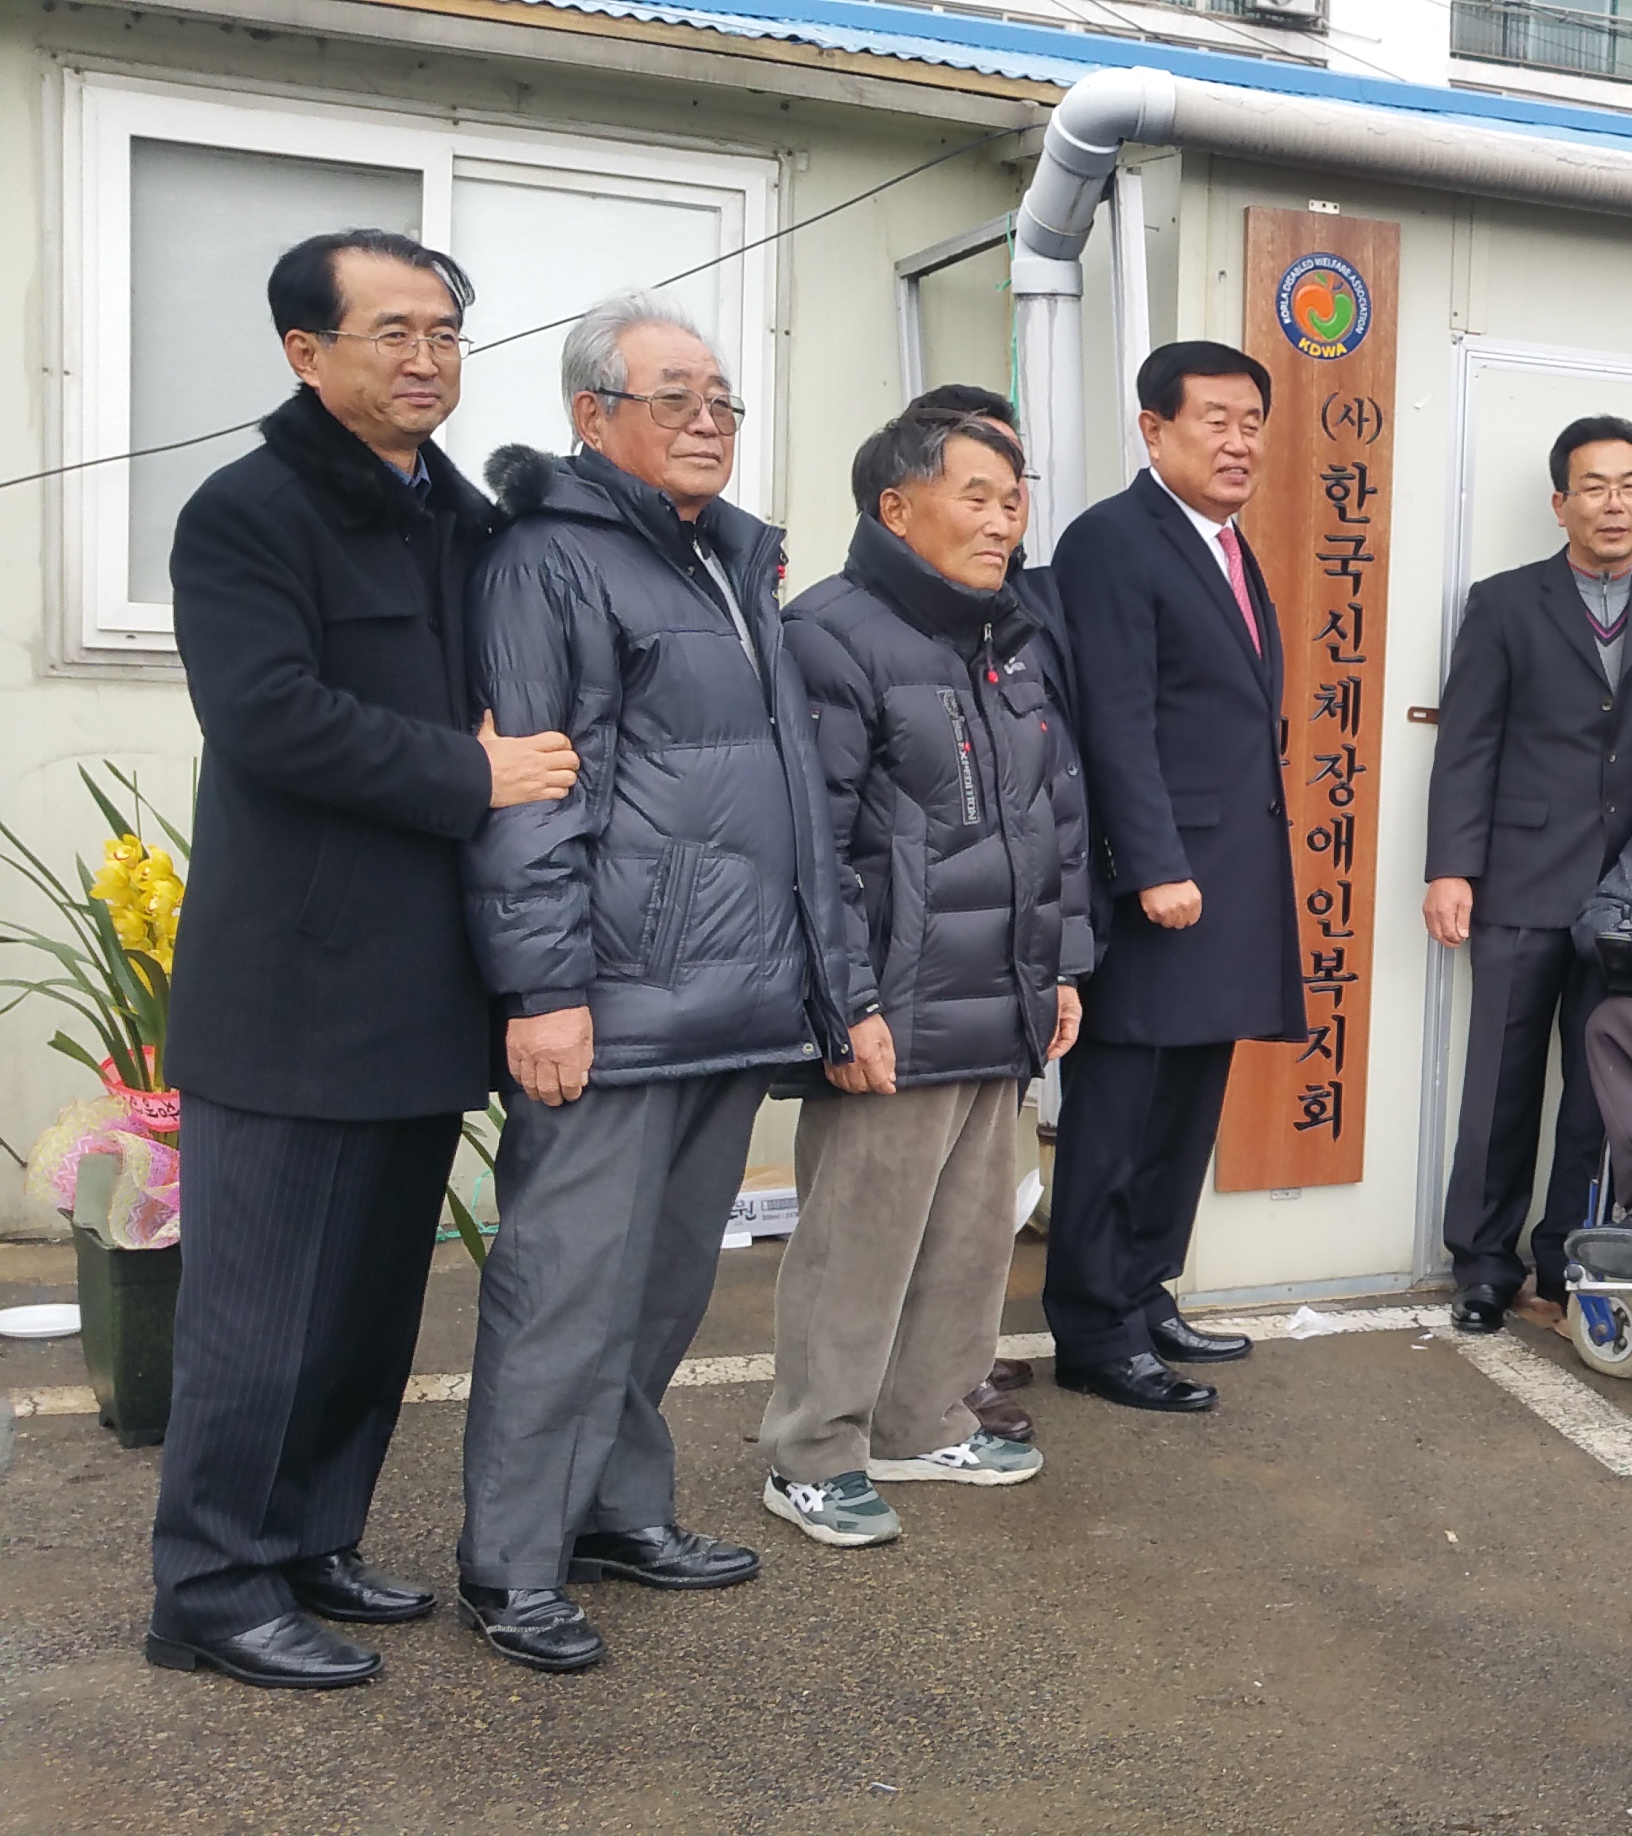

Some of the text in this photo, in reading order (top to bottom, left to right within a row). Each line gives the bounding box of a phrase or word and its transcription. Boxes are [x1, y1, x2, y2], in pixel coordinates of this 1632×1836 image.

[1315, 257, 1352, 278] WELFARE
[1349, 275, 1368, 334] ASSOCIATION
[1298, 337, 1347, 357] KDWA
